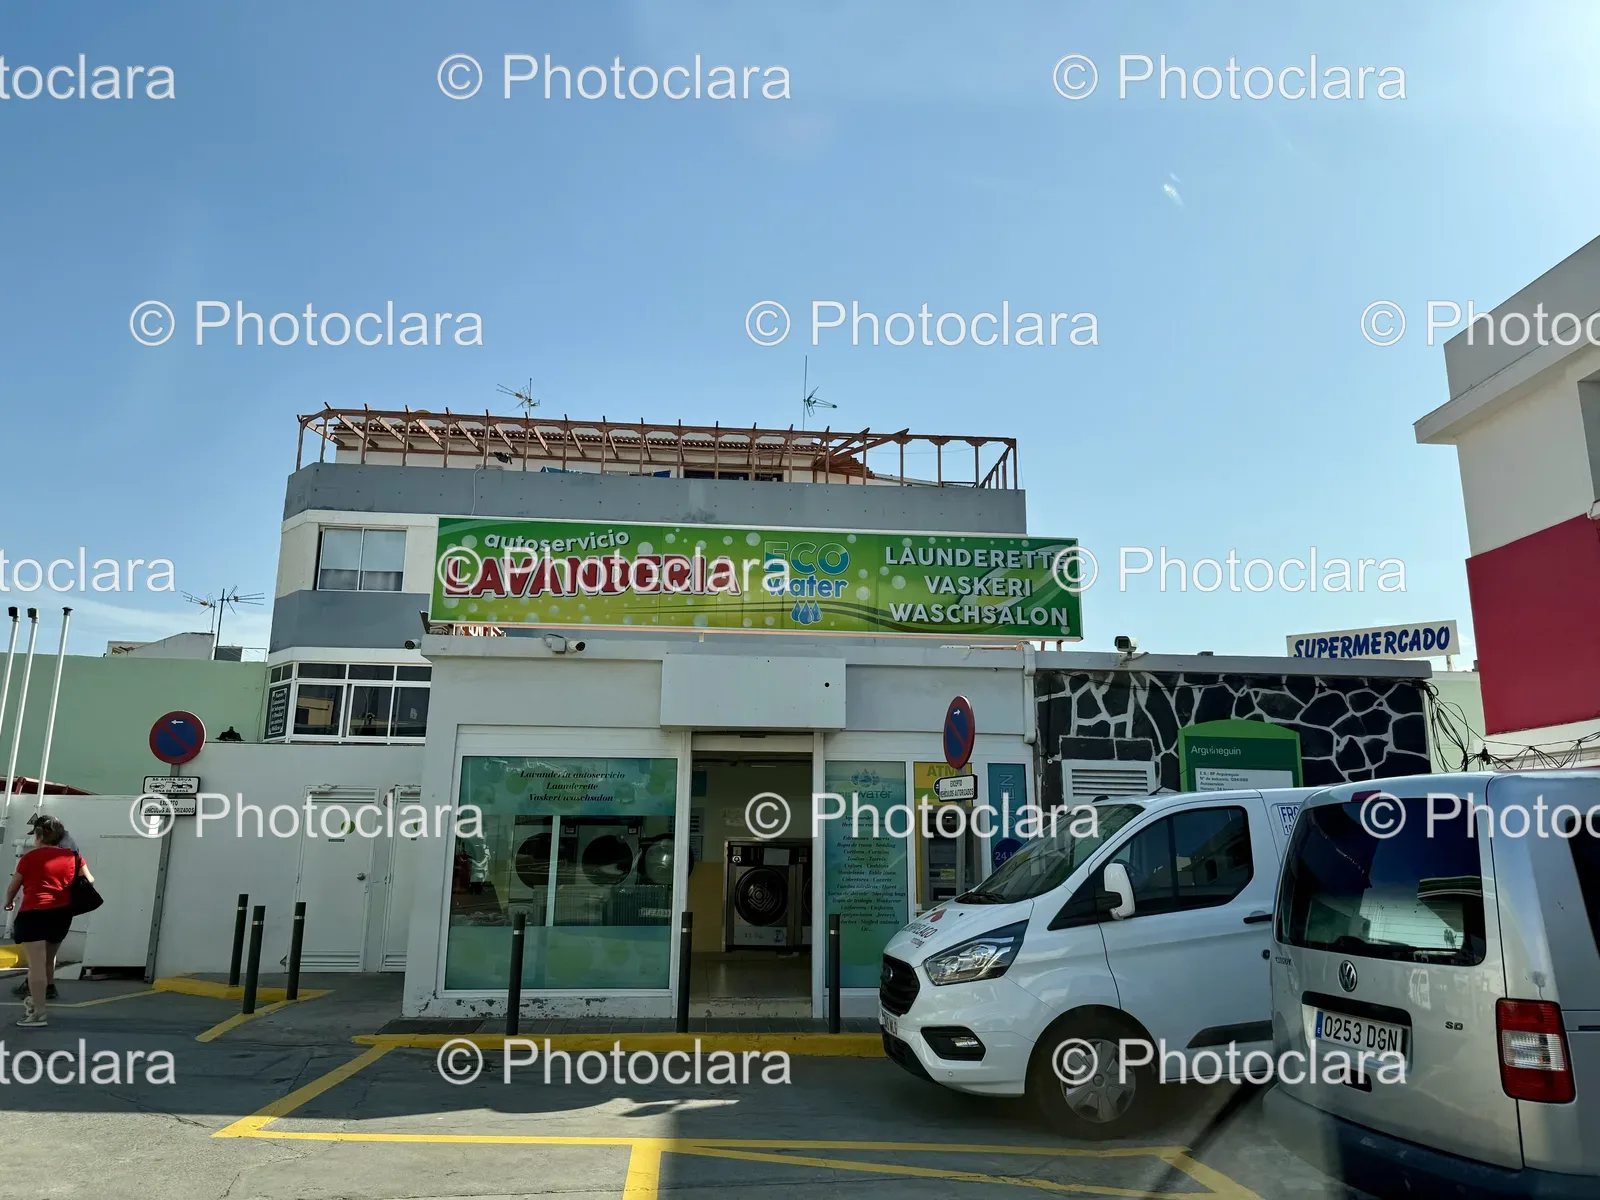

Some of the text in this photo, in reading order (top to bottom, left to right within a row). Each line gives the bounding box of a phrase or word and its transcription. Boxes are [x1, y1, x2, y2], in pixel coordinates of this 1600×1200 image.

[484, 529, 630, 552] autoservicio
[764, 541, 850, 575] ECO
[885, 547, 1068, 571] LAUNDERETTE
[444, 555, 741, 596] LAVANDERIA
[767, 574, 849, 599] water
[924, 574, 1031, 597] VASKERI
[889, 603, 1068, 627] WASCHSALON
[1294, 626, 1449, 660] SUPERMERCADO
[995, 852, 1008, 862] 24
[1324, 1015, 1398, 1053] 0253 DGN
